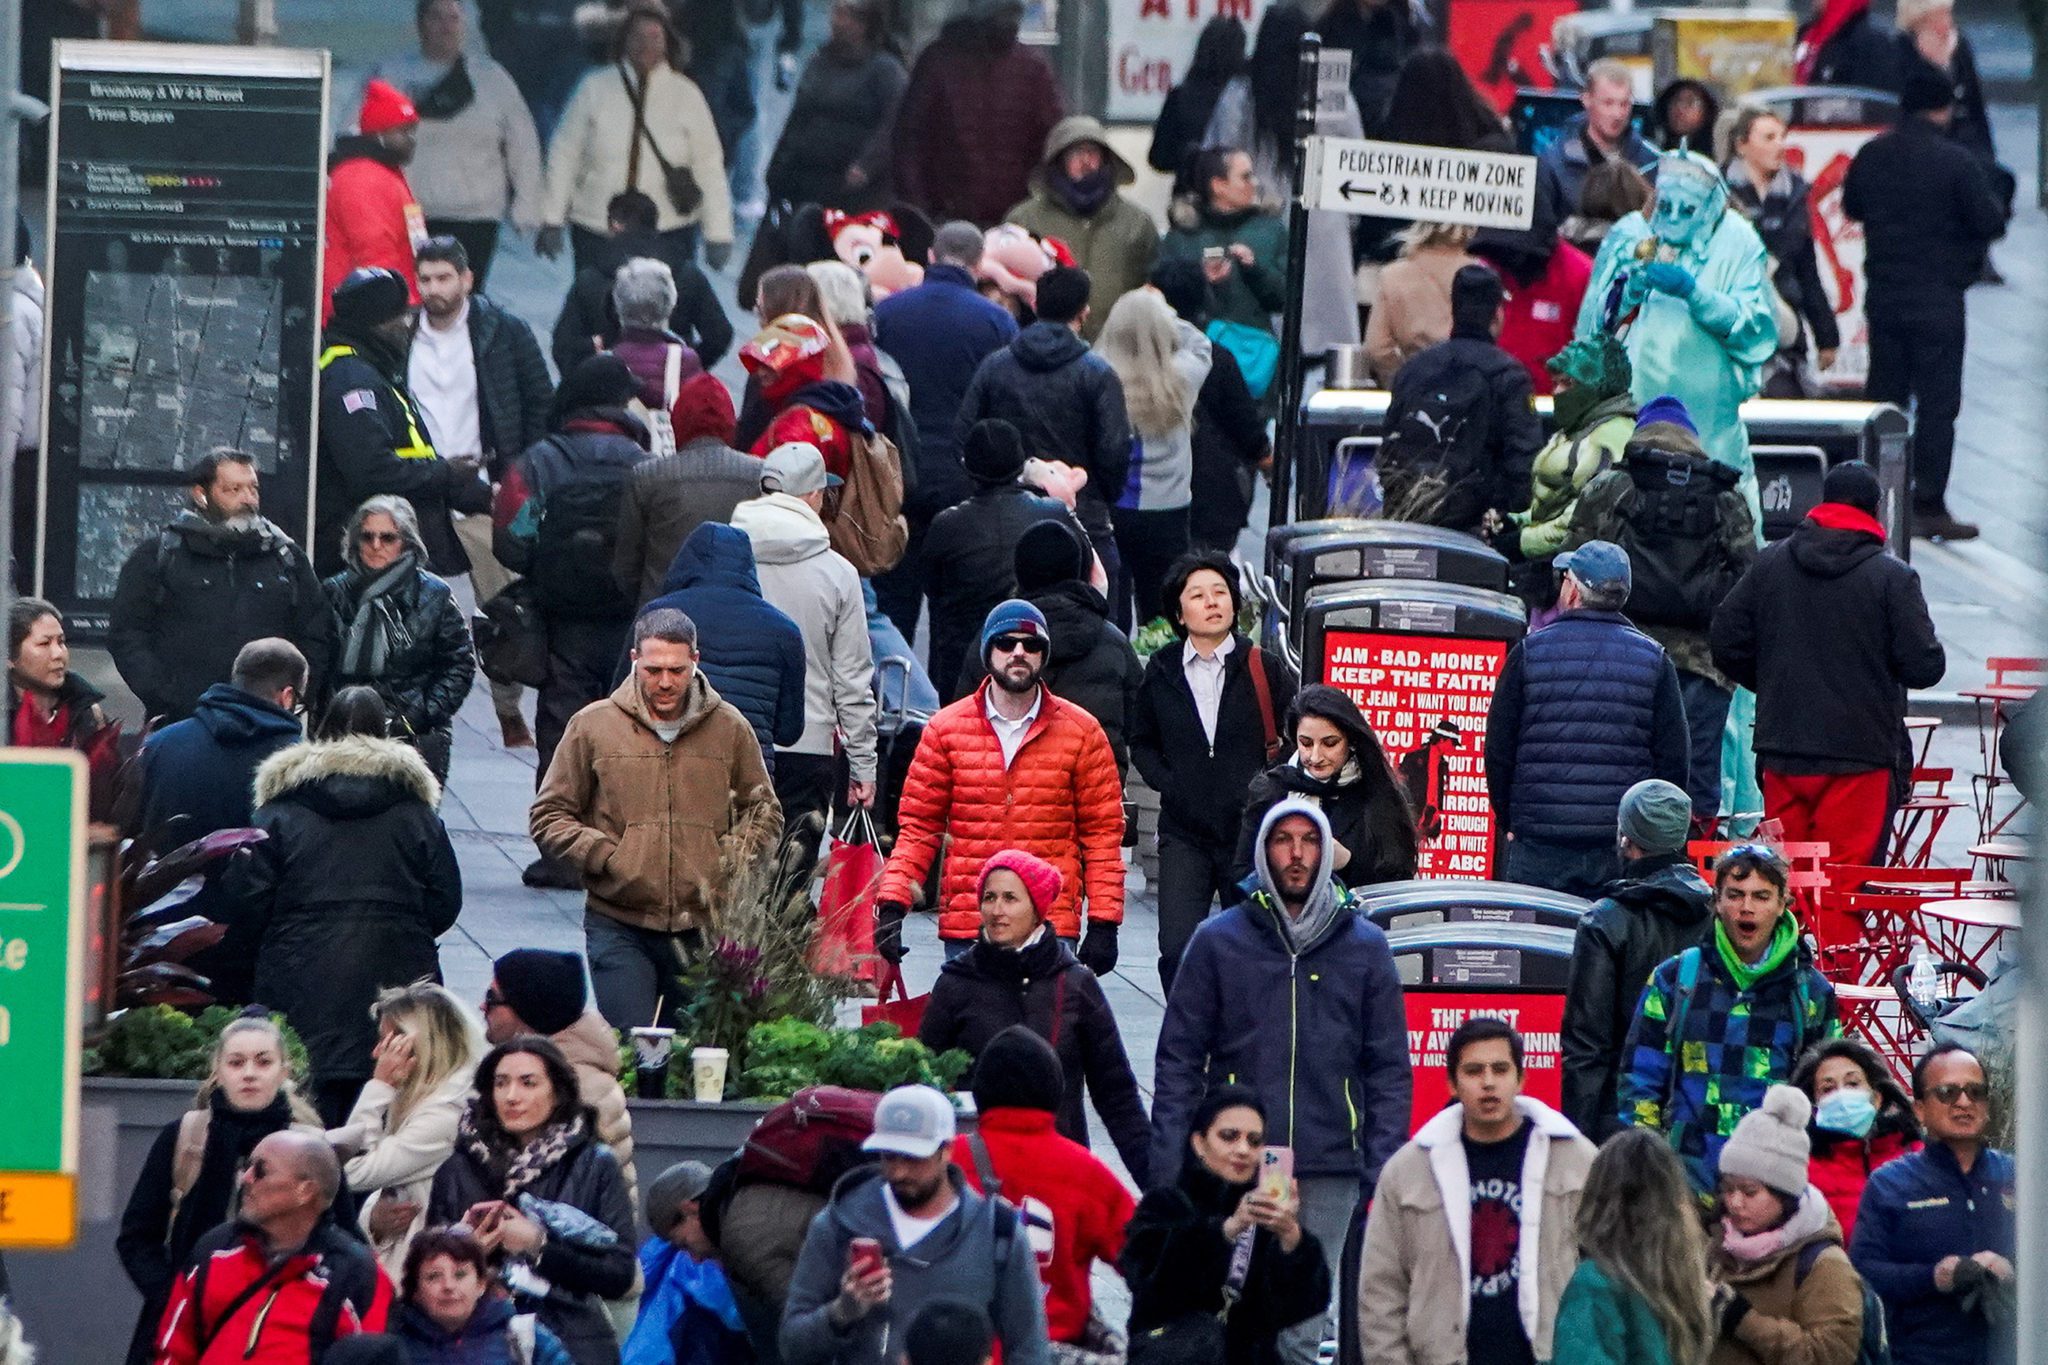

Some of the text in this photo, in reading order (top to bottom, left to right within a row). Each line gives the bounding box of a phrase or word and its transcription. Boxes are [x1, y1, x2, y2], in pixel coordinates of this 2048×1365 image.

[89, 81, 153, 100] Broadway
[168, 83, 184, 100] W
[204, 87, 244, 103] Street
[88, 104, 176, 125] Times Square
[1339, 149, 1526, 188] PEDESTRIAN FLOW ZONE
[1420, 186, 1524, 217] KEEP MOVING
[1331, 646, 1498, 672] JAM BAD MONEY
[1331, 666, 1497, 692] KEEP THE FAITH
[1366, 690, 1398, 707] JEAN
[1410, 692, 1415, 708] I
[1417, 693, 1445, 711] WANT
[1448, 695, 1468, 712] YOU
[1469, 696, 1492, 713] BAC
[1376, 710, 1391, 727] IT
[1395, 711, 1413, 728] ON
[1448, 715, 1488, 733] OOGI
[1374, 730, 1414, 748] YOU
[1442, 795, 1490, 813] IRROR
[1447, 815, 1489, 833] ENOUGH
[1444, 834, 1457, 851] OR
[1459, 835, 1488, 853] WHITE
[1449, 854, 1486, 872] ABC
[1431, 1008, 1465, 1029] THE
[1521, 1054, 1555, 1069] YEAR!
